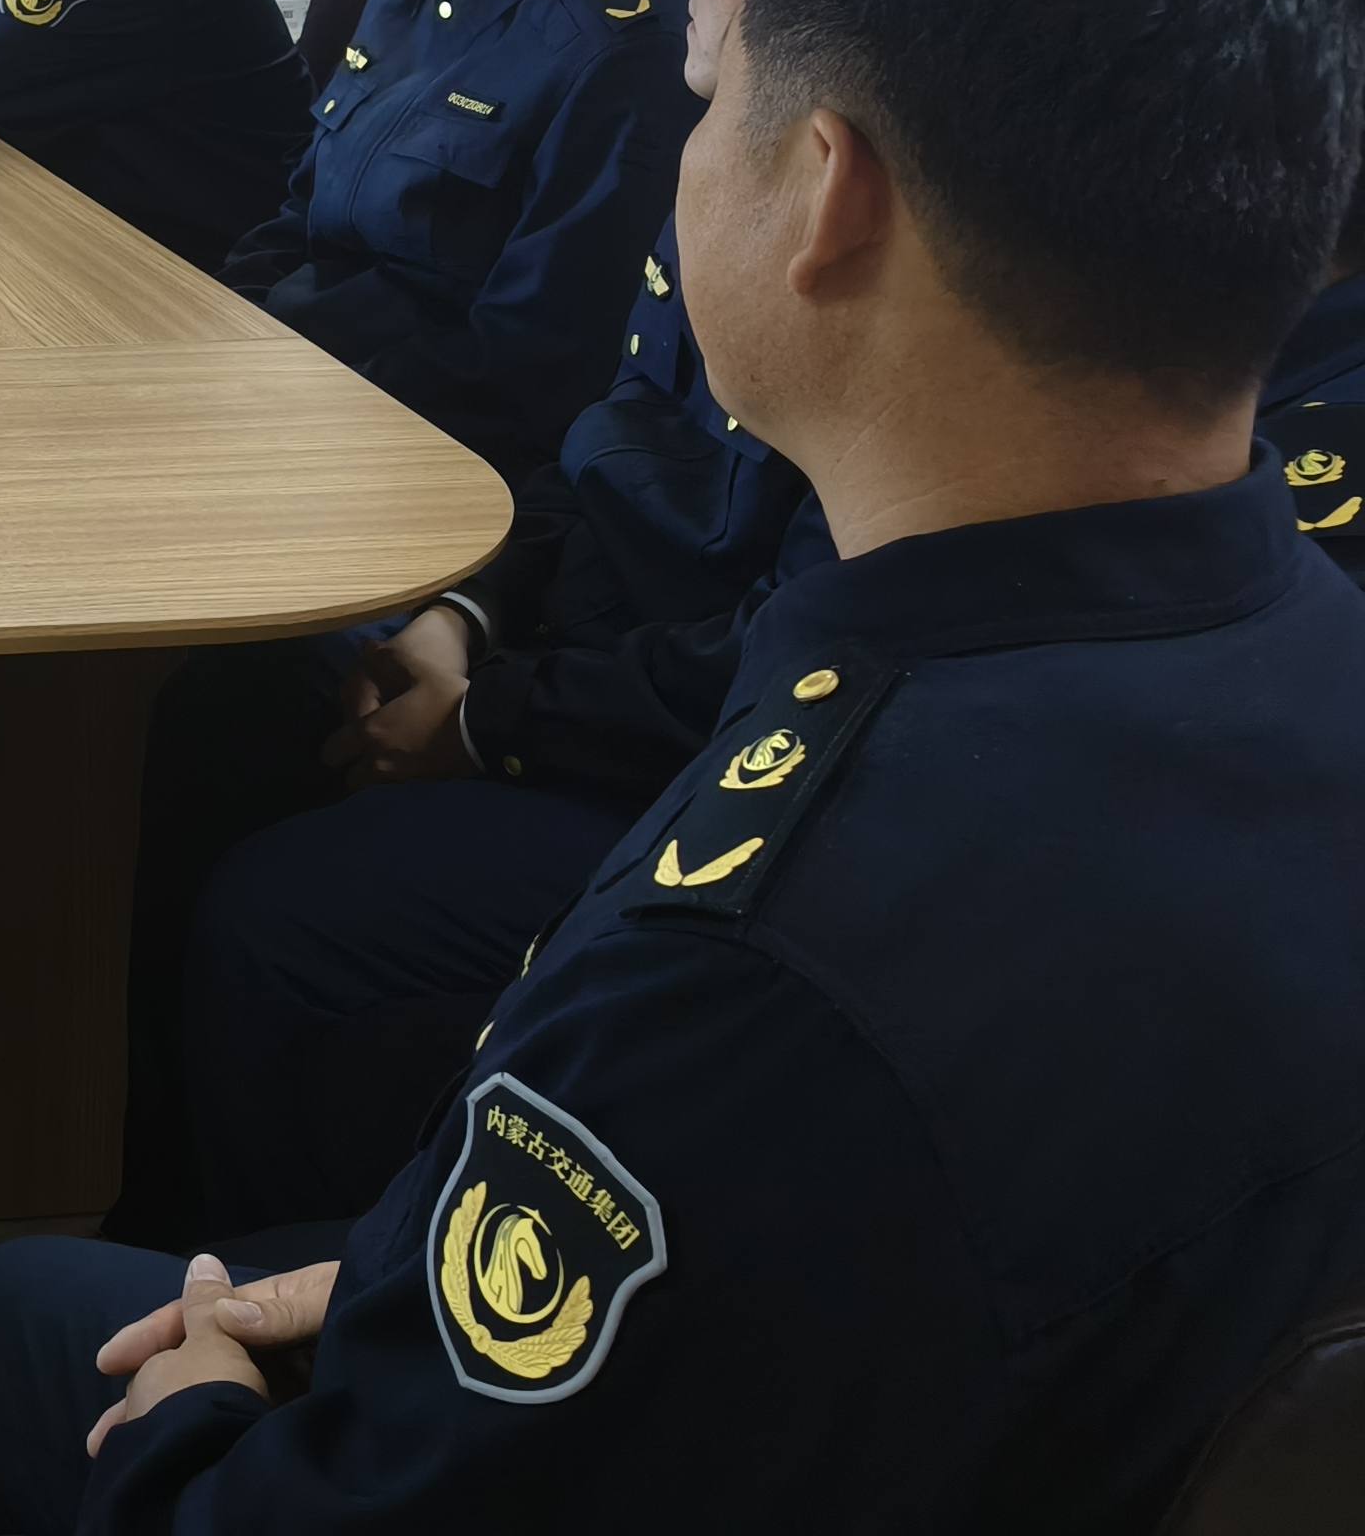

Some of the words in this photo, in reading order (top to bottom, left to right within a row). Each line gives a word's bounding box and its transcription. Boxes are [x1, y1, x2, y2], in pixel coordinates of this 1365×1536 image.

[486, 1105, 640, 1250] 内蒙古交通集团
